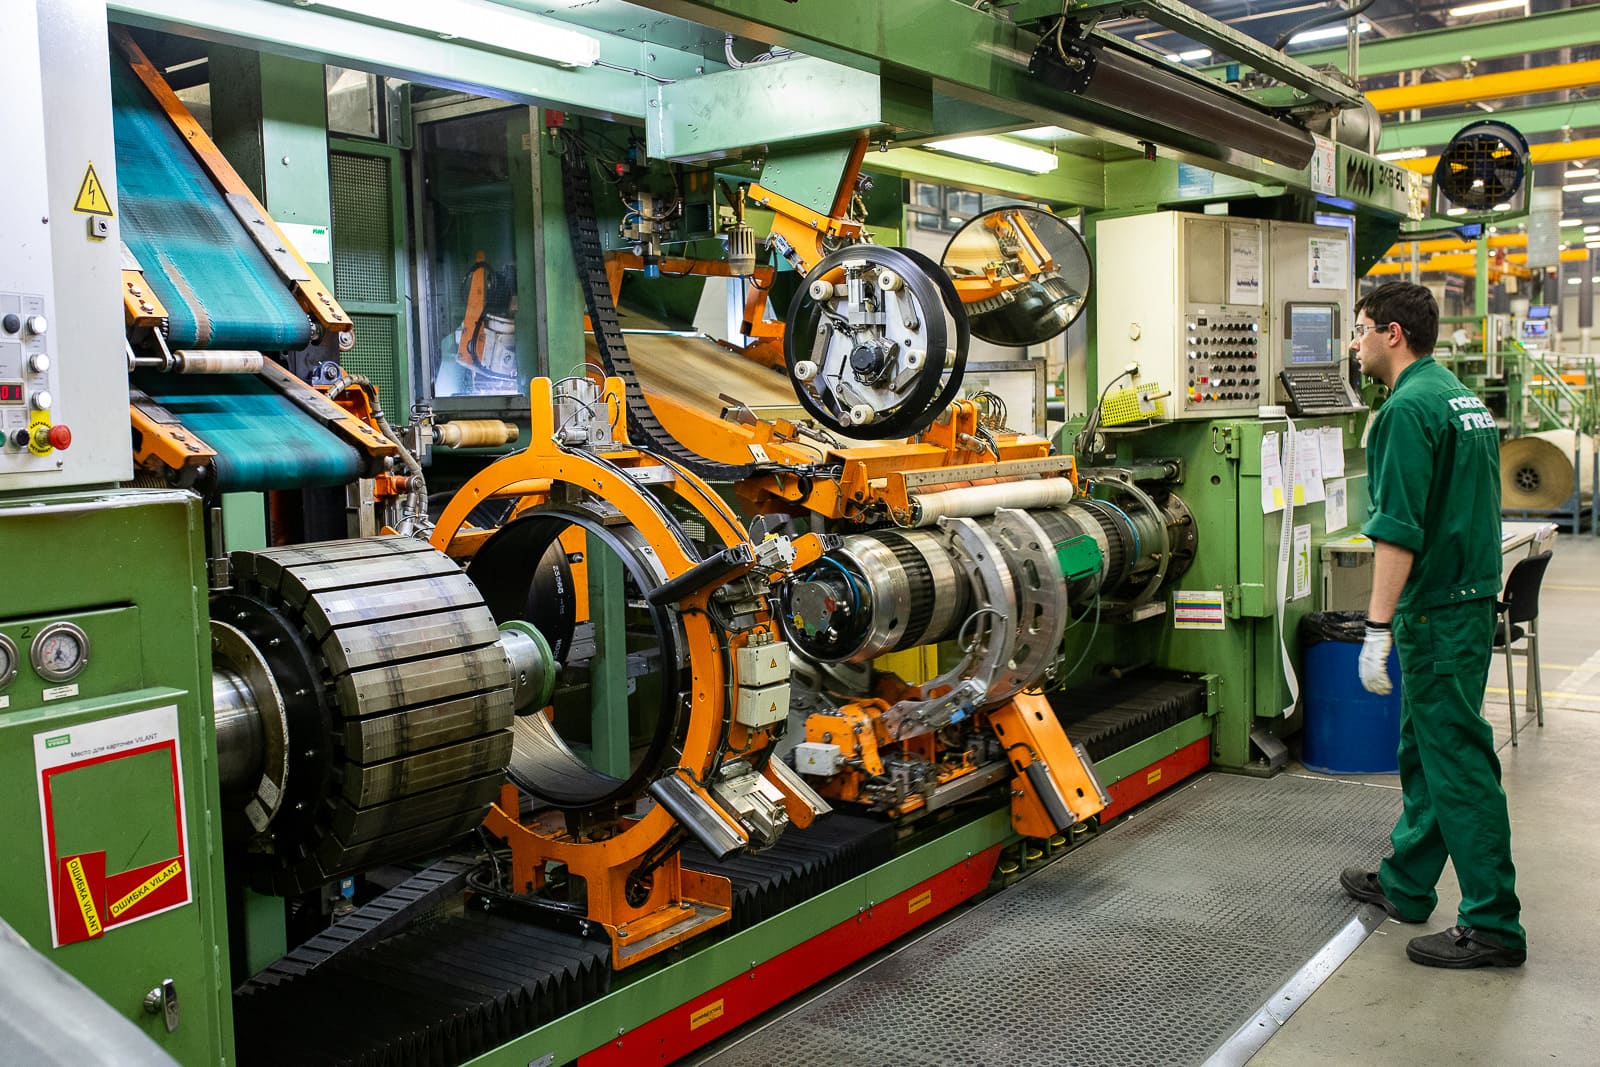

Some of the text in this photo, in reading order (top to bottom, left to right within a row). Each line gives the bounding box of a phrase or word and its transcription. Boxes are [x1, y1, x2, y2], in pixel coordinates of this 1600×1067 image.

[21, 626, 31, 639] 2
[71, 748, 92, 758] Место
[134, 733, 158, 743] VILANT
[70, 861, 99, 933] ОШИБКА VILANT
[112, 864, 179, 914] ОШИБКА VILANT
